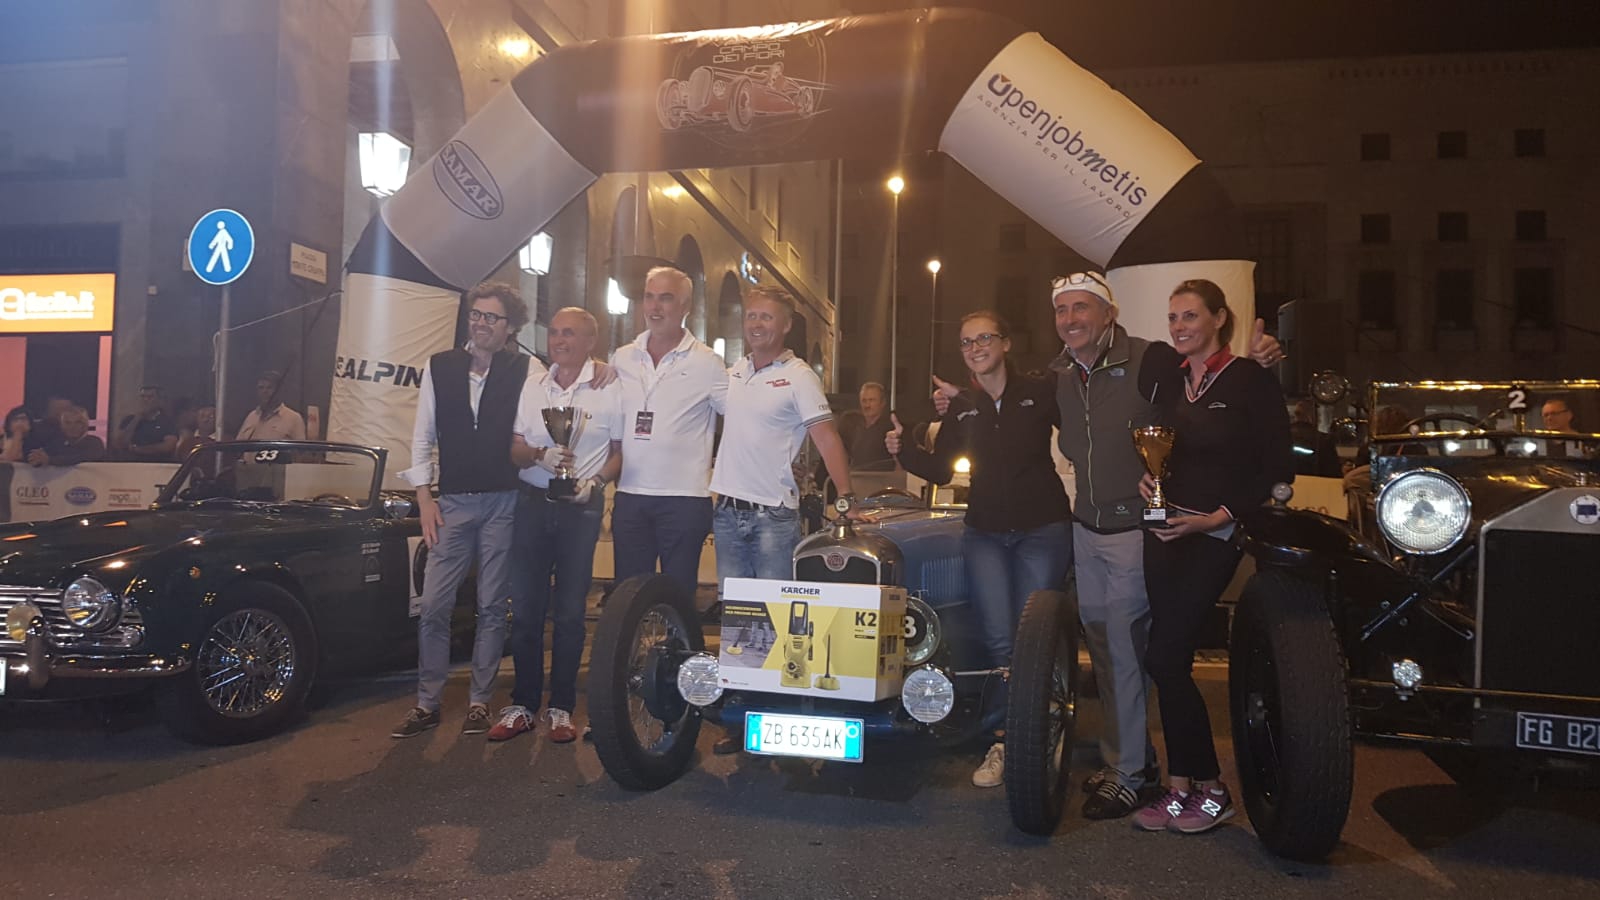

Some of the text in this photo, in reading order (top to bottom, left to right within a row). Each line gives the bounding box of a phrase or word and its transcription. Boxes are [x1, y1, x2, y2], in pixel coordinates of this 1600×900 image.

[720, 43, 780, 54] CAMPO
[977, 94, 1130, 218] AGENZIA PER IL LAVORO
[1508, 390, 1526, 409] 2
[255, 450, 279, 461] 33
[855, 611, 877, 626] K2
[763, 722, 843, 750] ZB 635AK
[1524, 718, 1553, 745] FG
